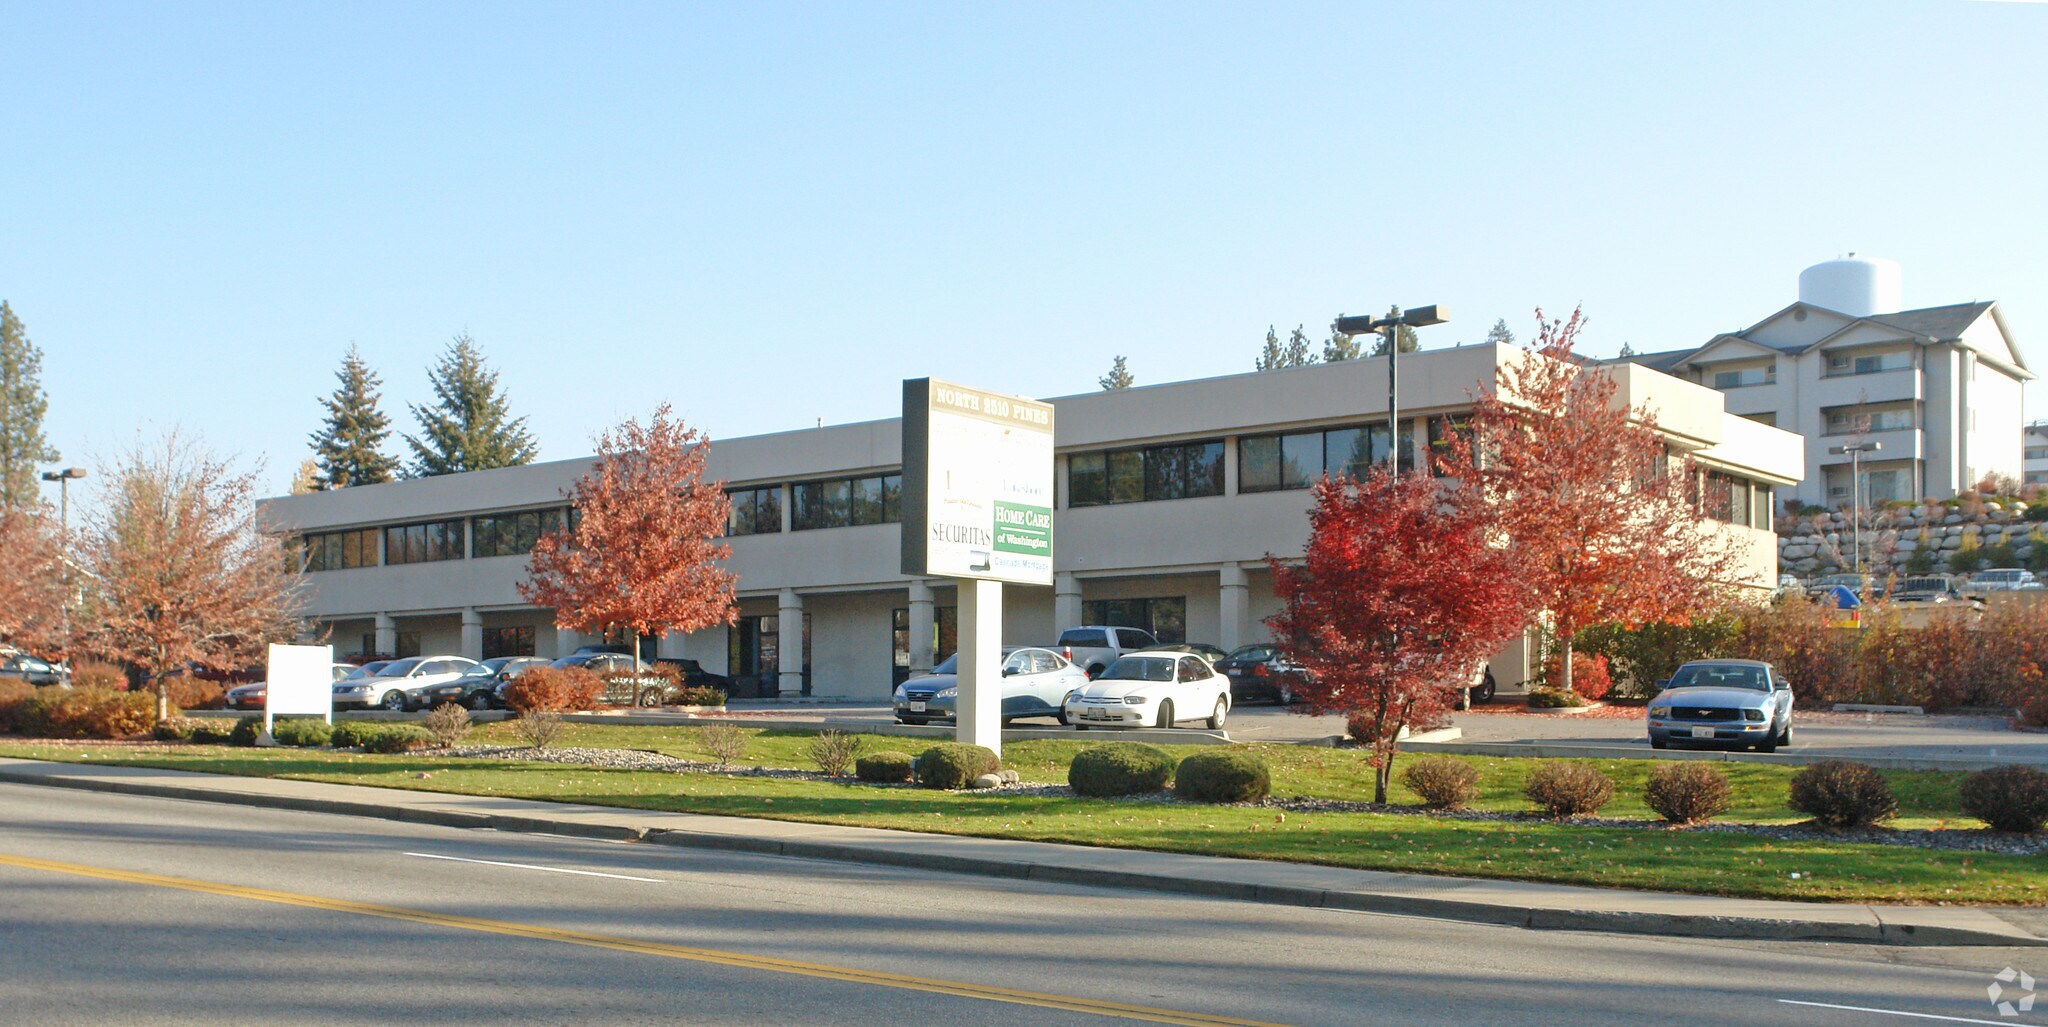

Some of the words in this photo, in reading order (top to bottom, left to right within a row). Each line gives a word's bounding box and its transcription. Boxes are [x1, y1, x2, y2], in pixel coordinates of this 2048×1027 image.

[936, 388, 980, 410] NORTH
[983, 398, 1010, 417] 2510
[1013, 405, 1049, 424] PINES
[995, 506, 1025, 525] HOME
[1025, 511, 1050, 529] CARE
[932, 522, 991, 547] SECURITAS
[997, 533, 1006, 543] of
[1006, 534, 1049, 549] Washington
